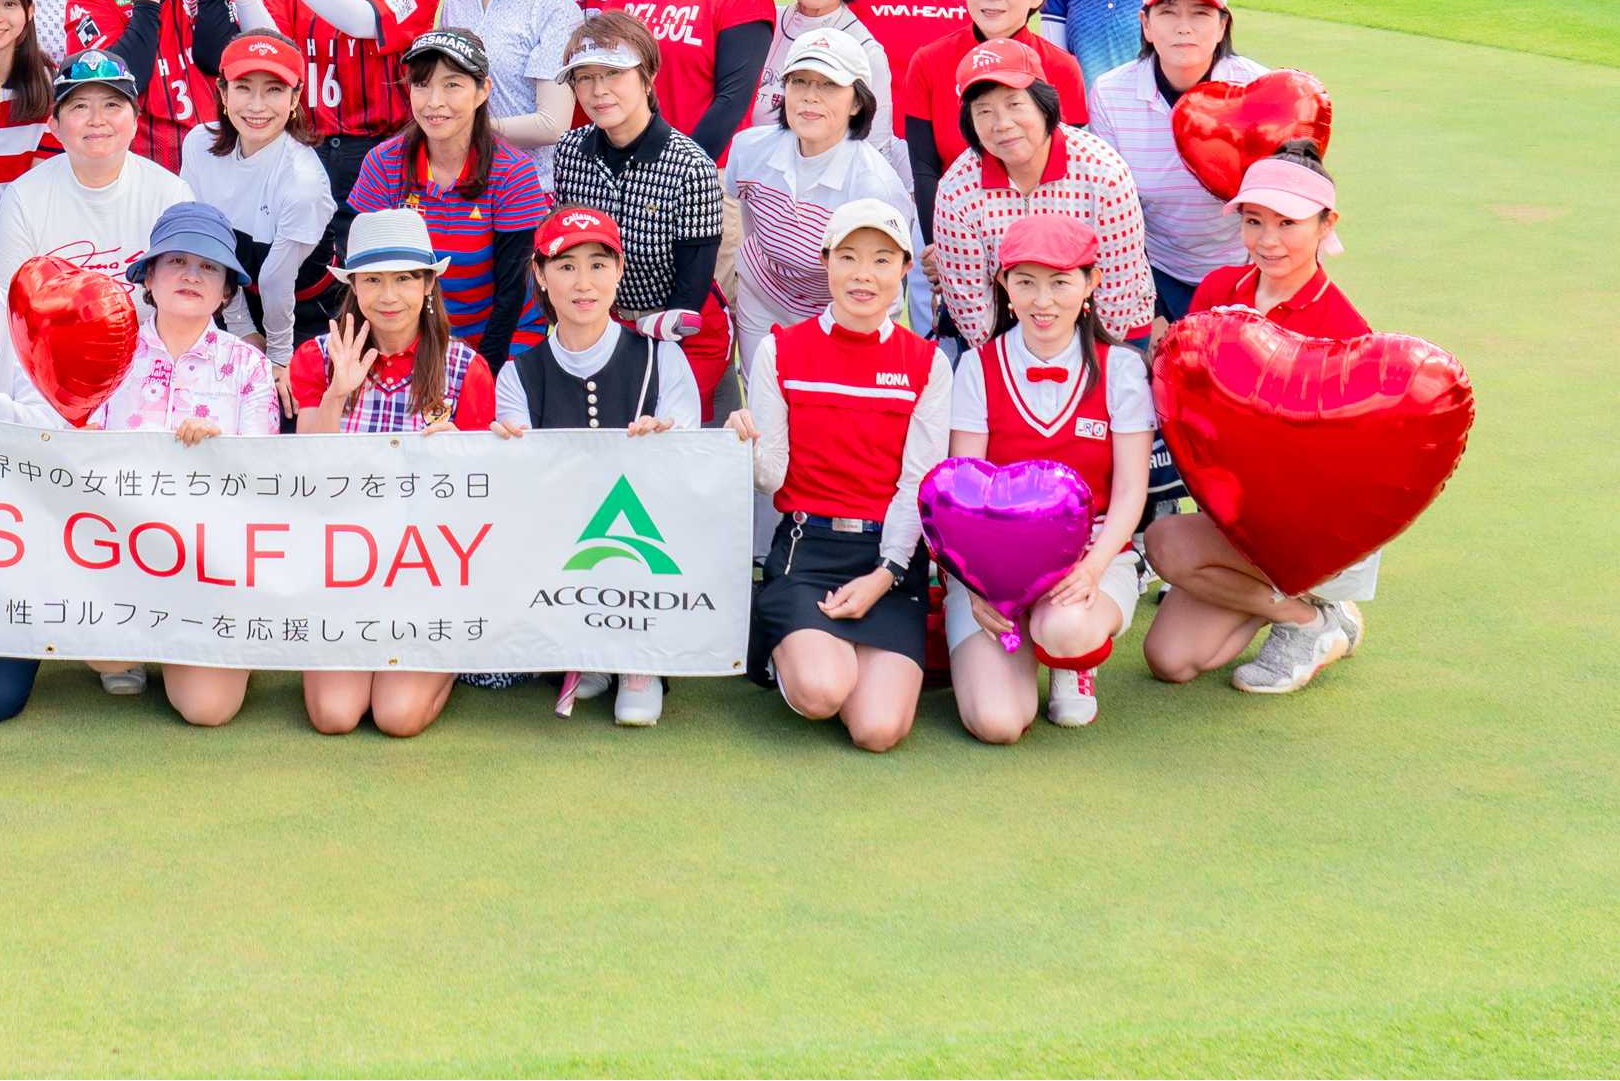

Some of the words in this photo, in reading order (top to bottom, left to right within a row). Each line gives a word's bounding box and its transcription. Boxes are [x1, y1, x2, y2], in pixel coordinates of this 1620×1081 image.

[871, 5, 910, 16] VIVA
[411, 35, 474, 59] KISSMARK
[308, 63, 342, 108] 16
[171, 79, 193, 121] 3
[562, 212, 600, 227] Callaway
[876, 371, 911, 387] MONA
[63, 511, 290, 588] GOLF
[324, 523, 493, 589] DAY
[529, 587, 716, 611] ACCORDIA
[584, 614, 657, 631] GOLF
